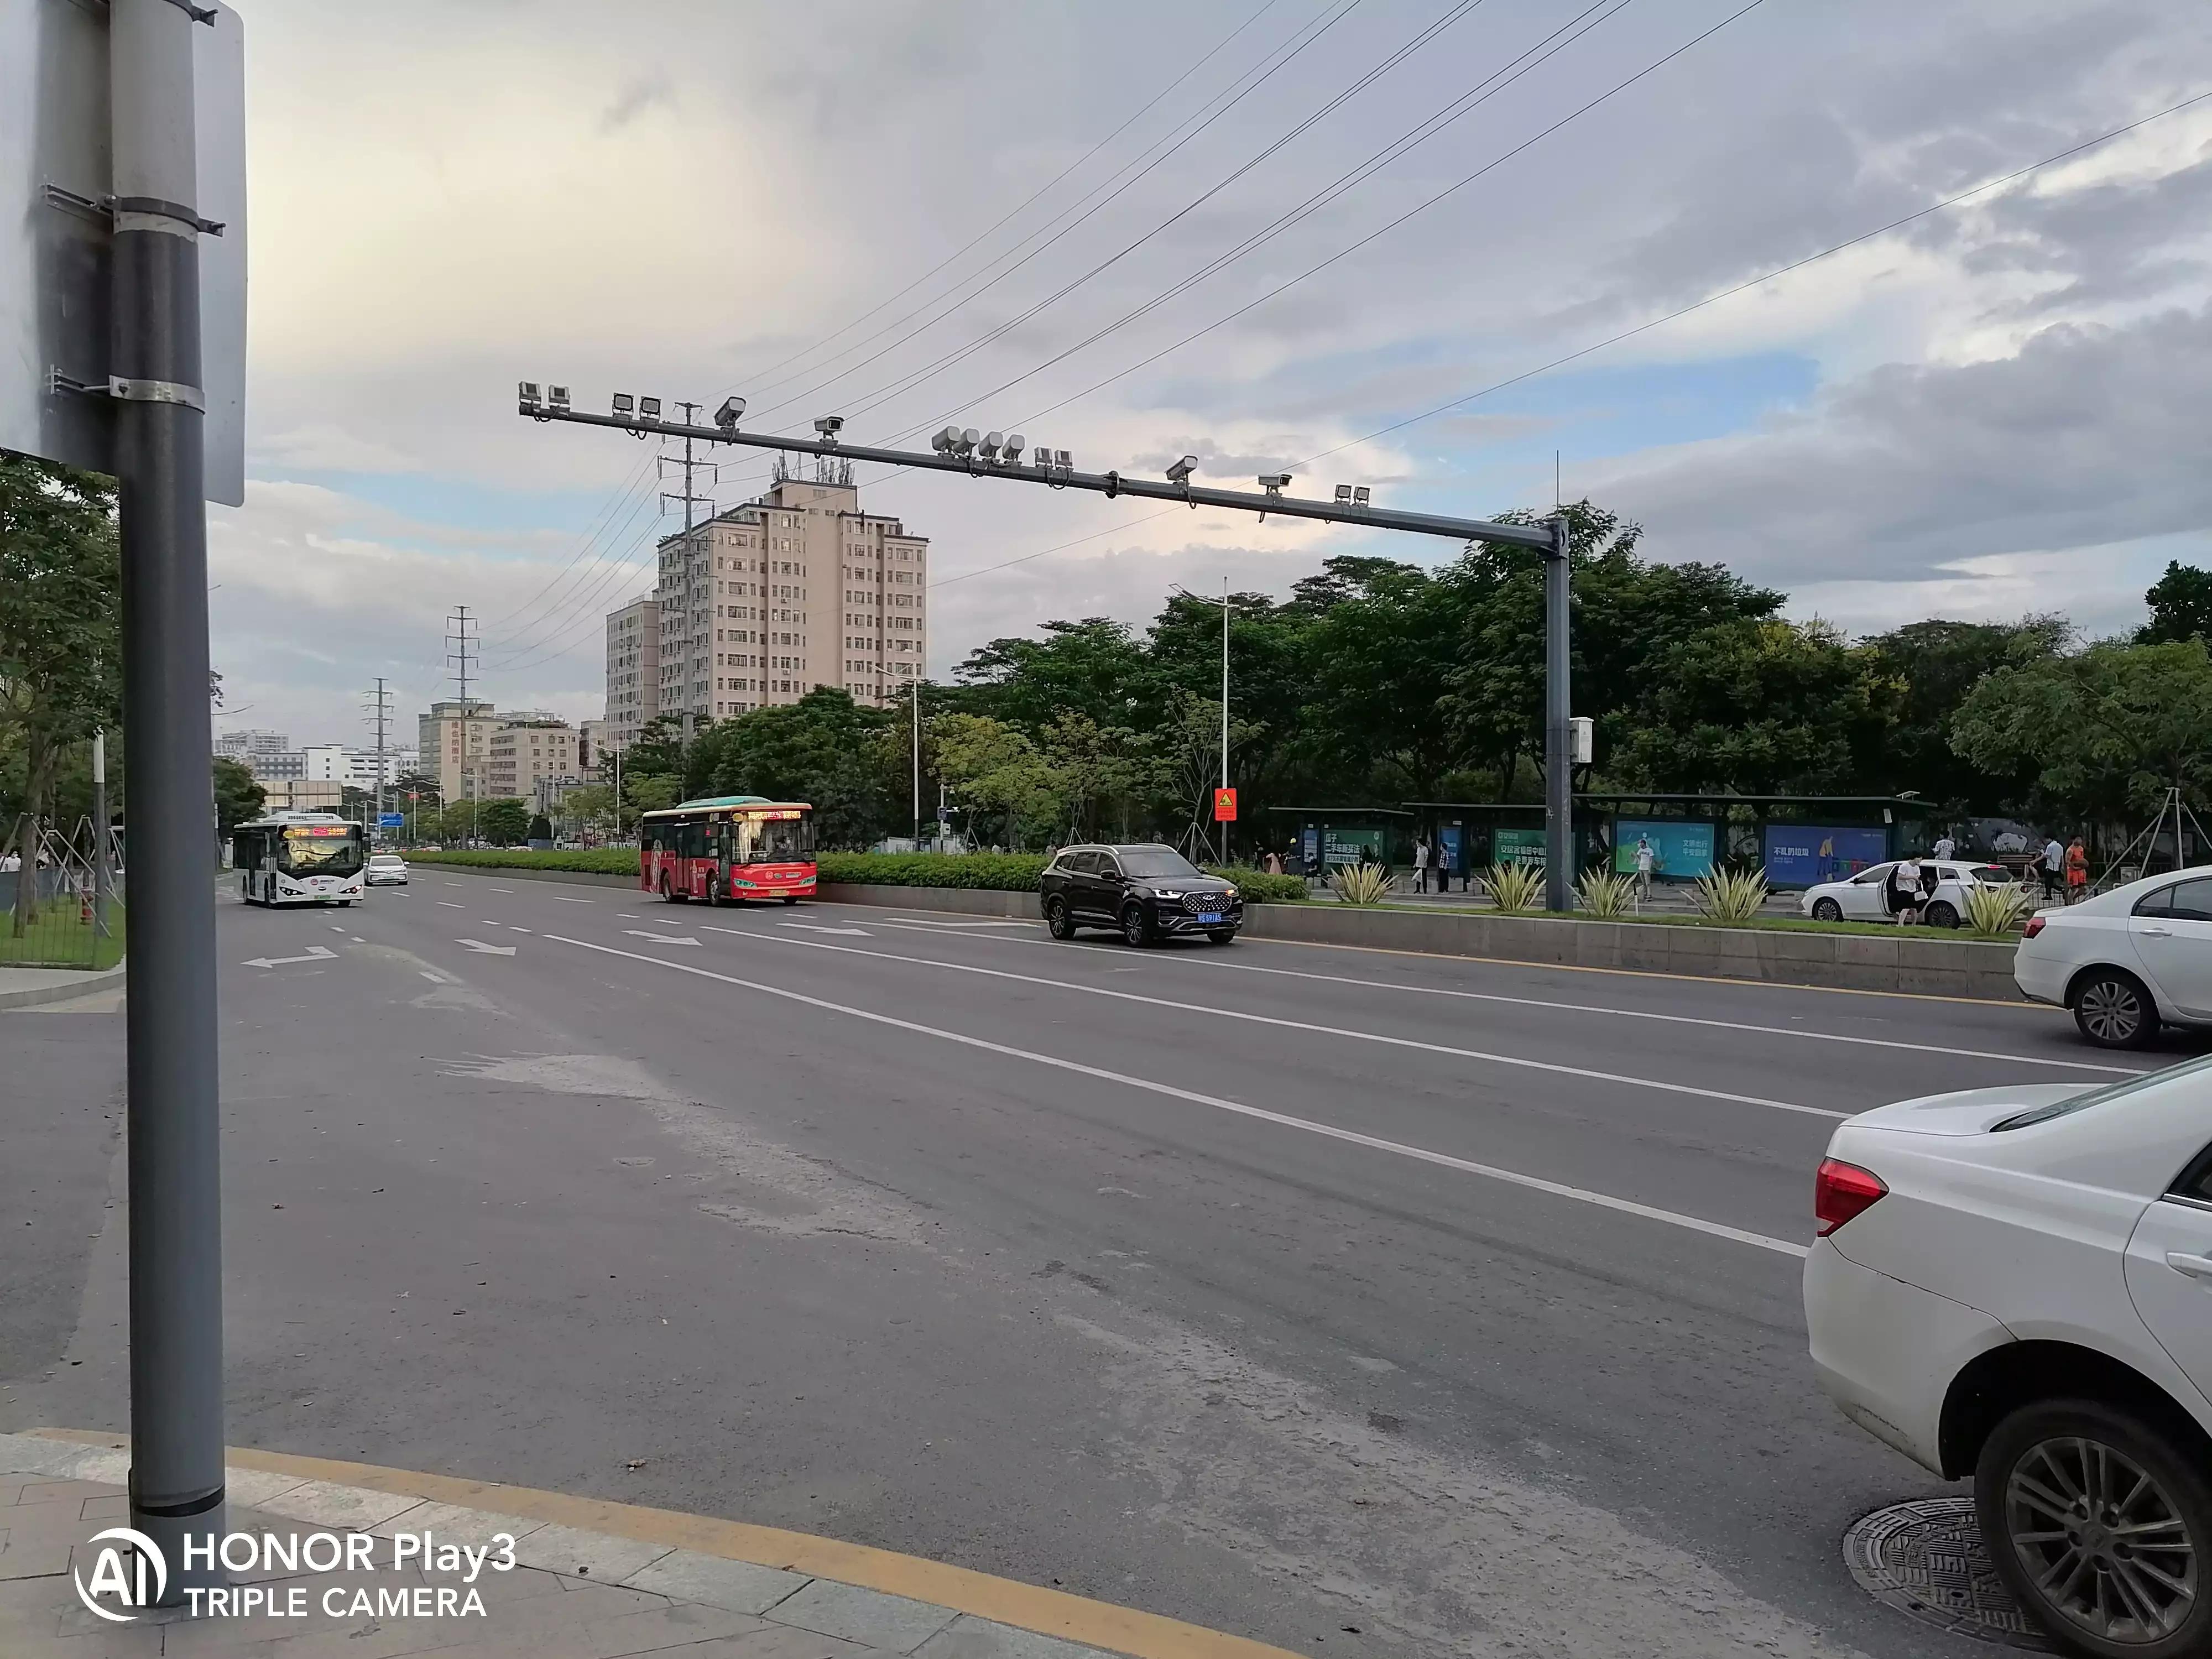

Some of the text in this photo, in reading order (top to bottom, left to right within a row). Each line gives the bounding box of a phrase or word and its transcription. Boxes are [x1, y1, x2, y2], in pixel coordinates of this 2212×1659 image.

[1773, 847, 1809, 857] 不乱扔垃圾
